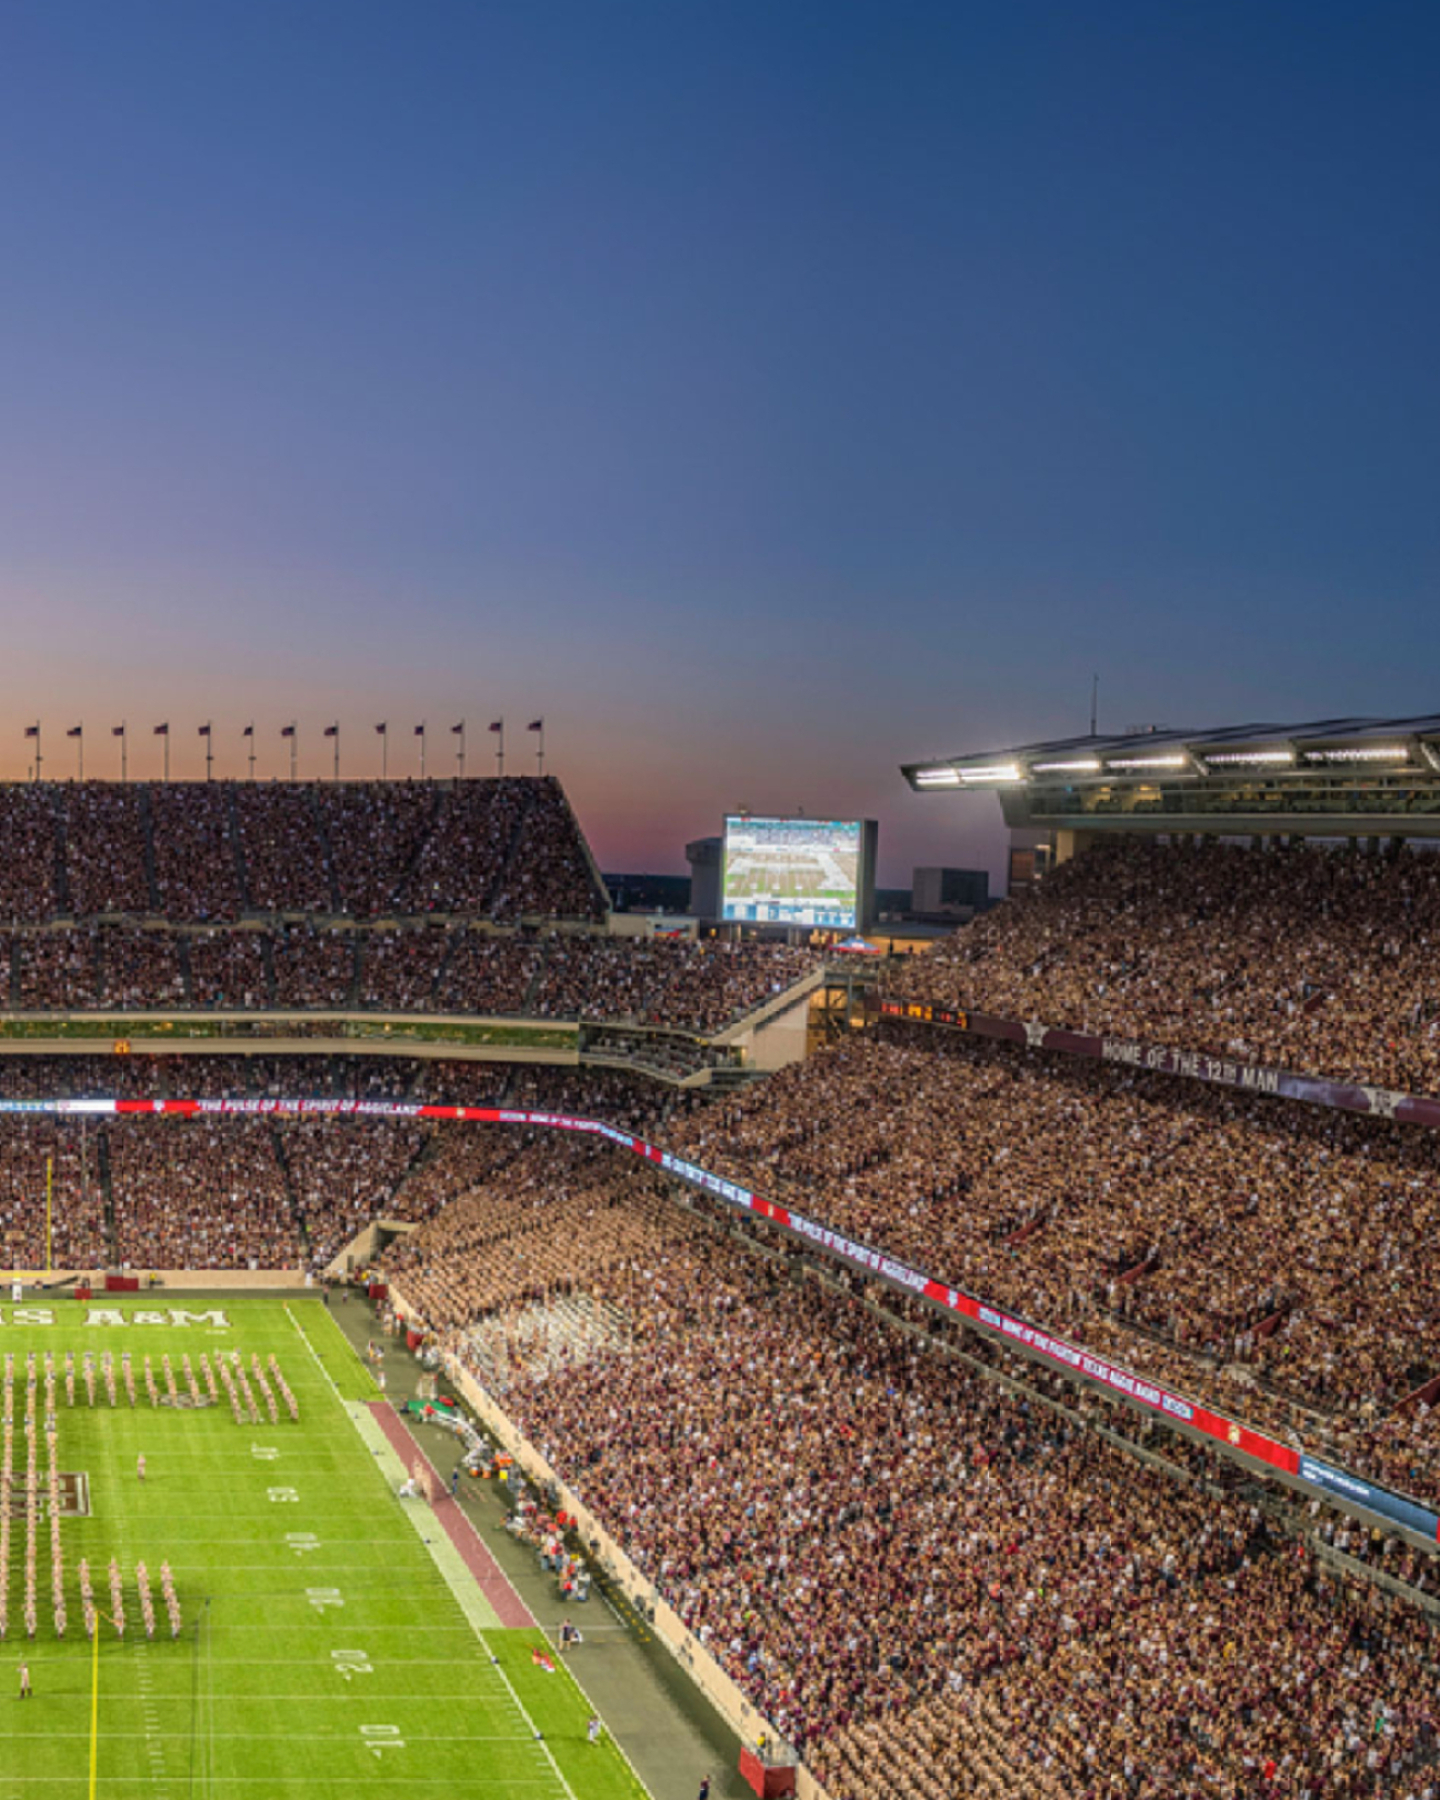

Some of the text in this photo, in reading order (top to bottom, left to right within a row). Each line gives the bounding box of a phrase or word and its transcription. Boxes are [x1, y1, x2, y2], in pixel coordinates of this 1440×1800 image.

[1102, 1043, 1140, 1067] HOME
[1147, 1049, 1165, 1070] OF
[1171, 1053, 1200, 1077] THE
[1243, 1066, 1278, 1092] MAN
[83, 1309, 232, 1328] A&M
[330, 1649, 374, 1673] 20
[359, 1724, 406, 1747] 10
